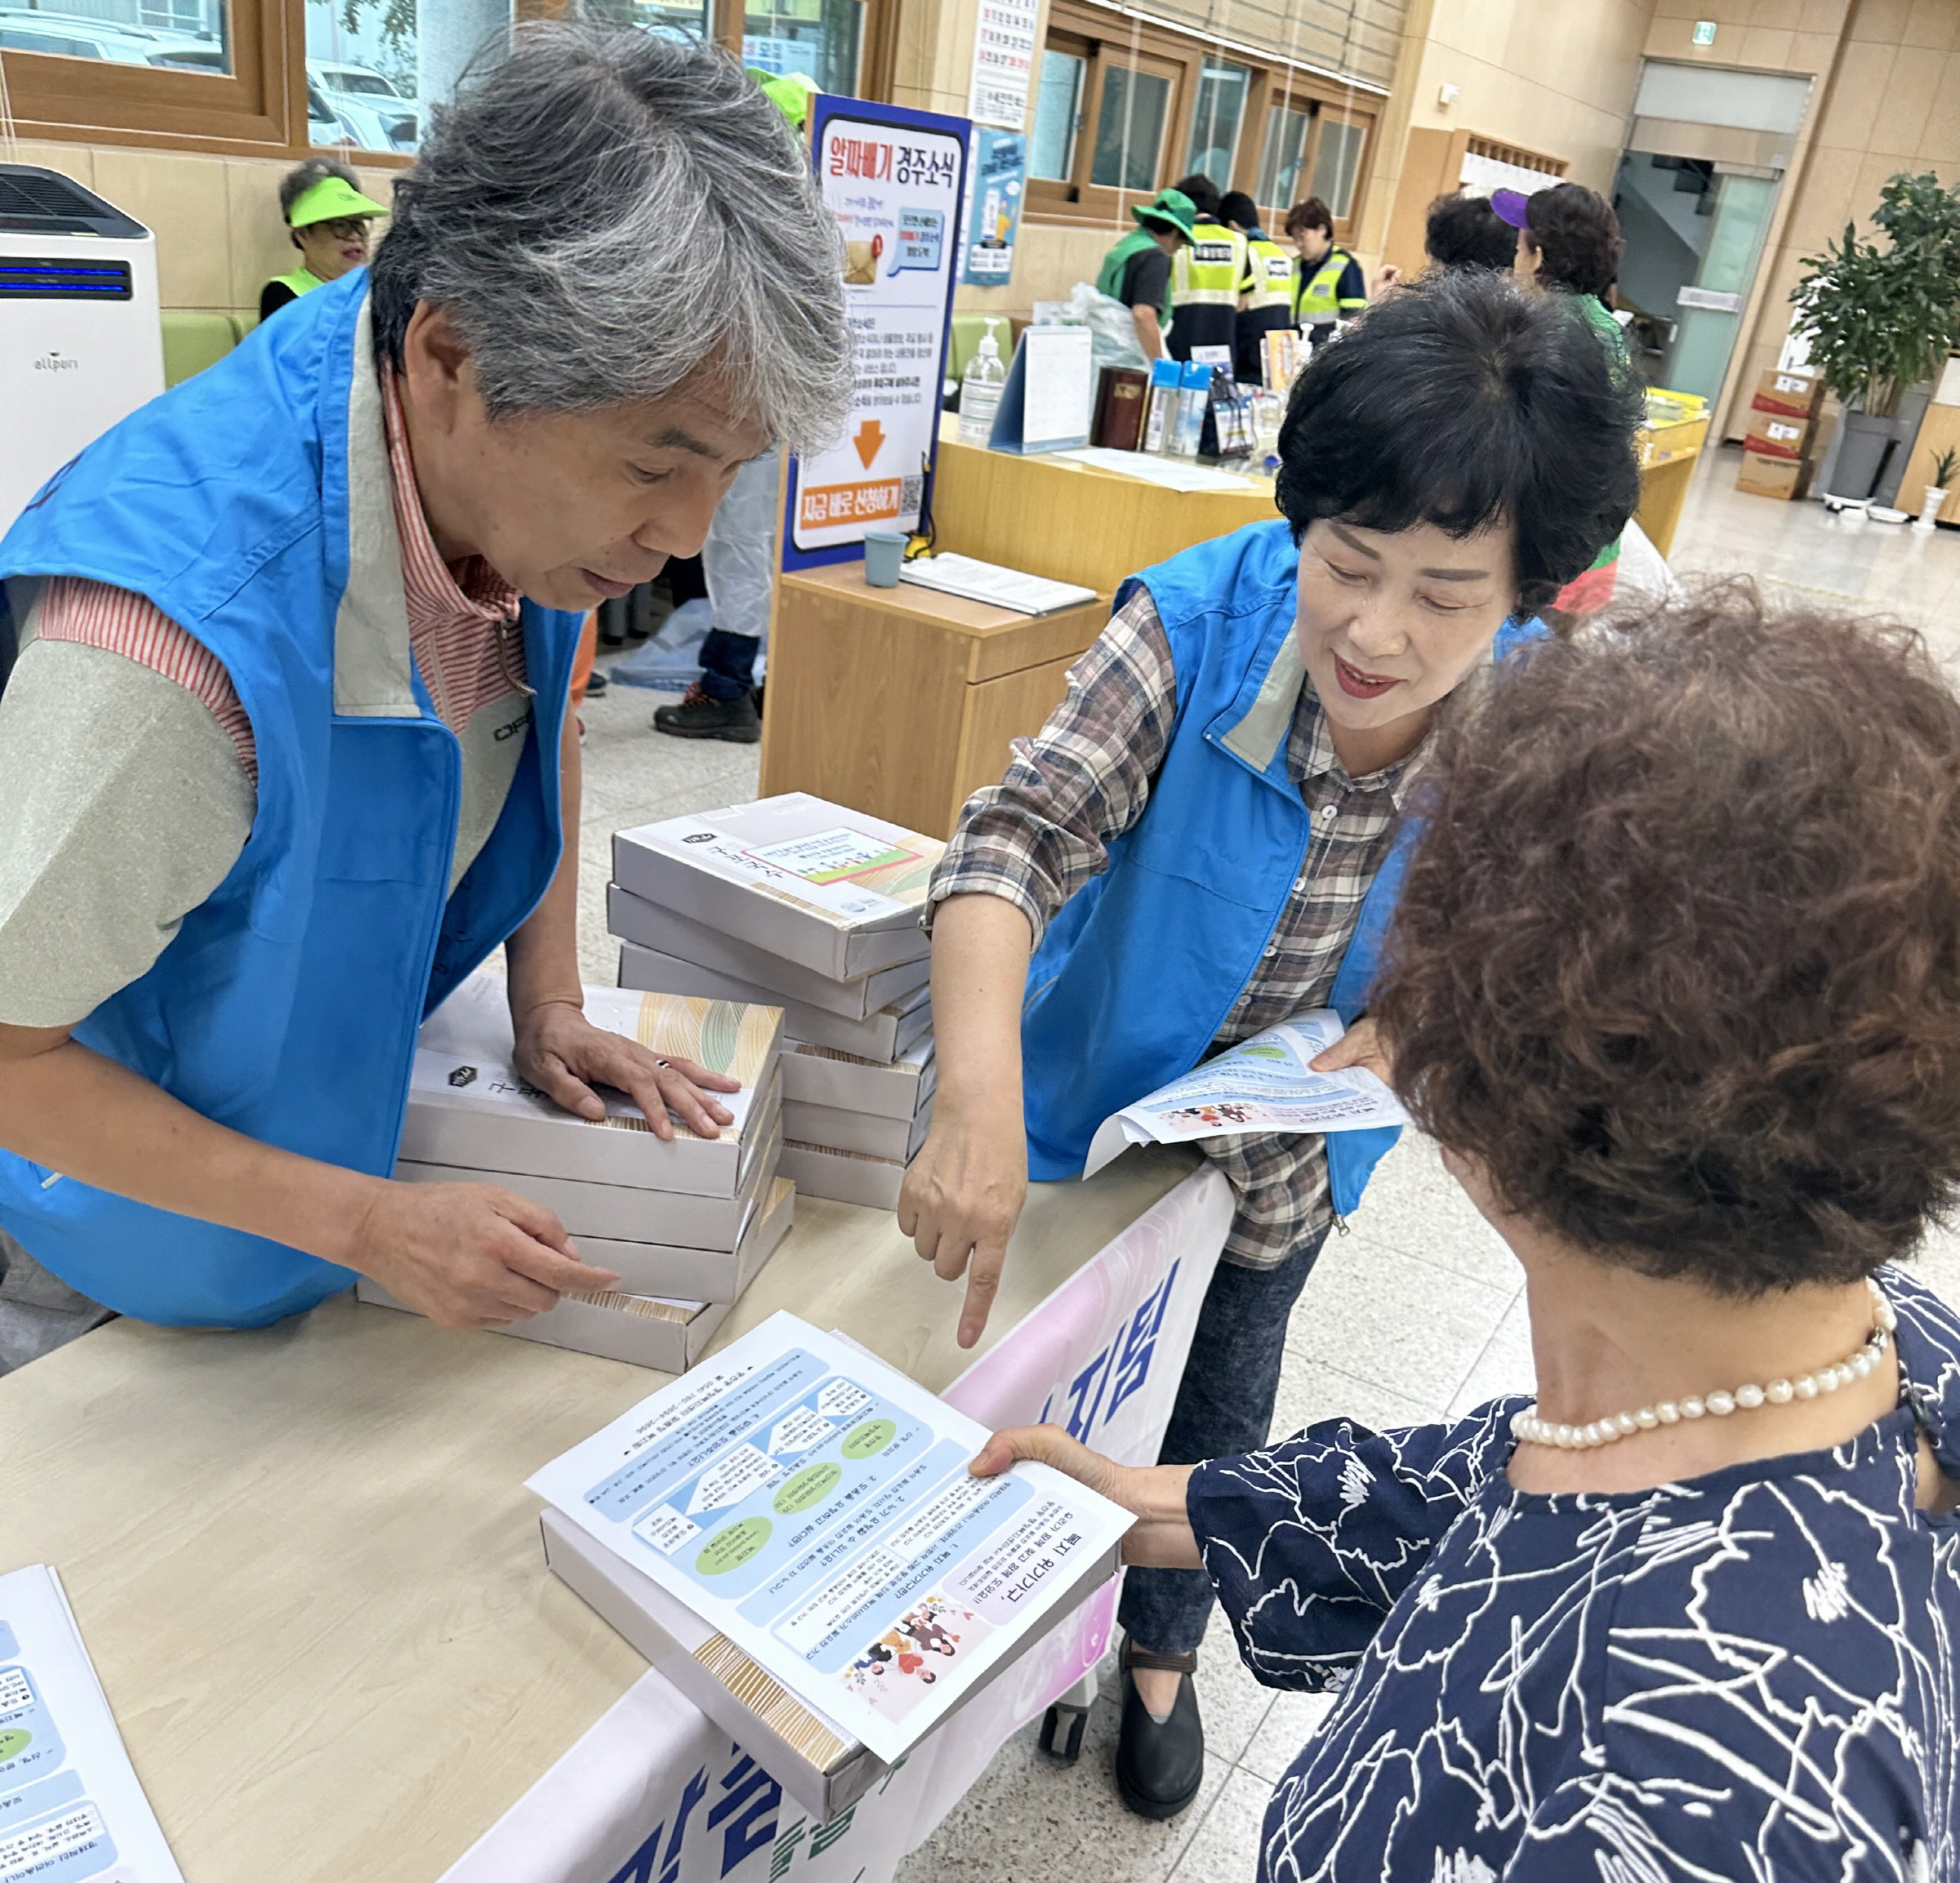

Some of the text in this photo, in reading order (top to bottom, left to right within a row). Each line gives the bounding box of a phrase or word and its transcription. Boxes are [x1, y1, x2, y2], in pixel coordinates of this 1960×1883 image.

[897, 145, 955, 189] 경주소식
[802, 483, 899, 521] 지금 바로 신청하기
[1039, 1258, 1181, 1446] 지팀
[679, 1387, 723, 1416] 행정복지센터
[728, 1420, 751, 1436] 무엇을
[687, 1436, 728, 1467] 도와주나요?
[907, 1463, 927, 1479] 도움이
[844, 1482, 867, 1500] 도움을
[890, 1477, 910, 1493] 필요한
[988, 1481, 1012, 1500] 경제적인
[814, 1500, 844, 1525] 요청하고
[853, 1507, 872, 1524] 도움이
[878, 1503, 897, 1517] 누가
[834, 1523, 854, 1539] 필요한
[856, 1516, 880, 1536] 요청할
[1034, 1517, 1050, 1530] 도움이
[787, 1524, 814, 1547] 싶다면?
[889, 1537, 901, 1547] 가구
[902, 1536, 914, 1546] 가구
[923, 1529, 934, 1538] 가구
[992, 1517, 1037, 1556] 행정복지센터에서
[1019, 1529, 1036, 1544] 필요한
[815, 1539, 835, 1553] 이웃을
[819, 1542, 848, 1566] 있나요?
[920, 1543, 938, 1560] 사회적
[906, 1558, 921, 1571] 고립
[933, 1551, 951, 1565] 복지
[972, 1511, 1073, 1604] 우리가 함께 찾고 함께 도와요!!
[982, 1555, 995, 1565] 직접
[991, 1556, 1007, 1570] 있으면
[1000, 1532, 1082, 1602] 복지 위기가구,
[768, 1577, 790, 1594] 누구나
[888, 1570, 909, 1587] 등으로
[893, 1565, 934, 1599] 위기가구란?
[826, 1595, 839, 1605] 가구
[874, 1586, 889, 1598] 인해
[796, 1610, 808, 1621] 가구
[838, 1598, 876, 1630] 복지서비스가
[818, 1628, 840, 1648] 필요한
[805, 1646, 820, 1660] 가구
